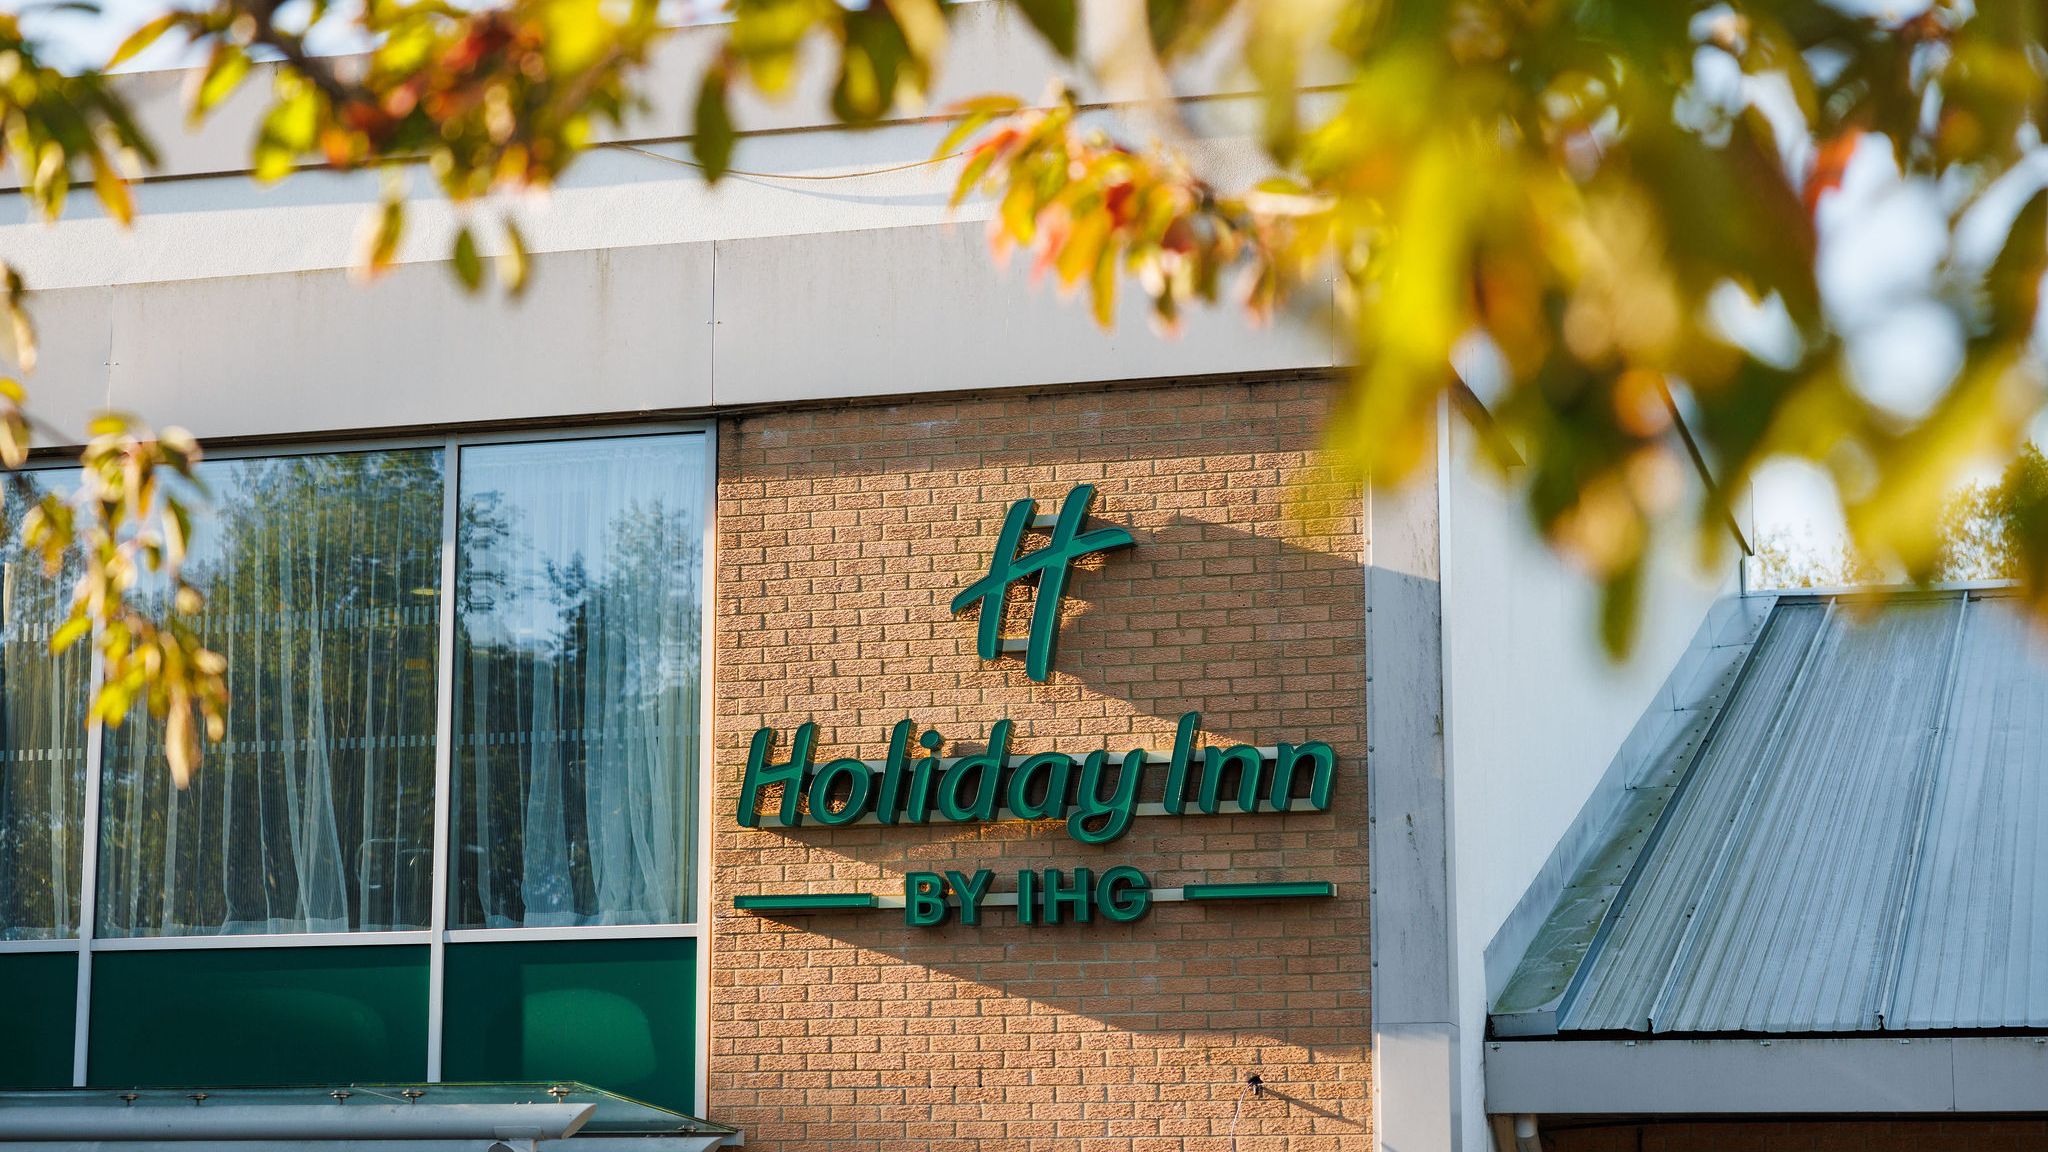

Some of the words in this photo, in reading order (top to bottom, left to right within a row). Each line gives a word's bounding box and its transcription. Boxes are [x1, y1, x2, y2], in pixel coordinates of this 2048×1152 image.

[951, 483, 1138, 683] H
[736, 718, 1148, 845] Holiday
[1163, 711, 1338, 815] Inn
[905, 869, 996, 926] BY
[1018, 865, 1153, 925] IHG
